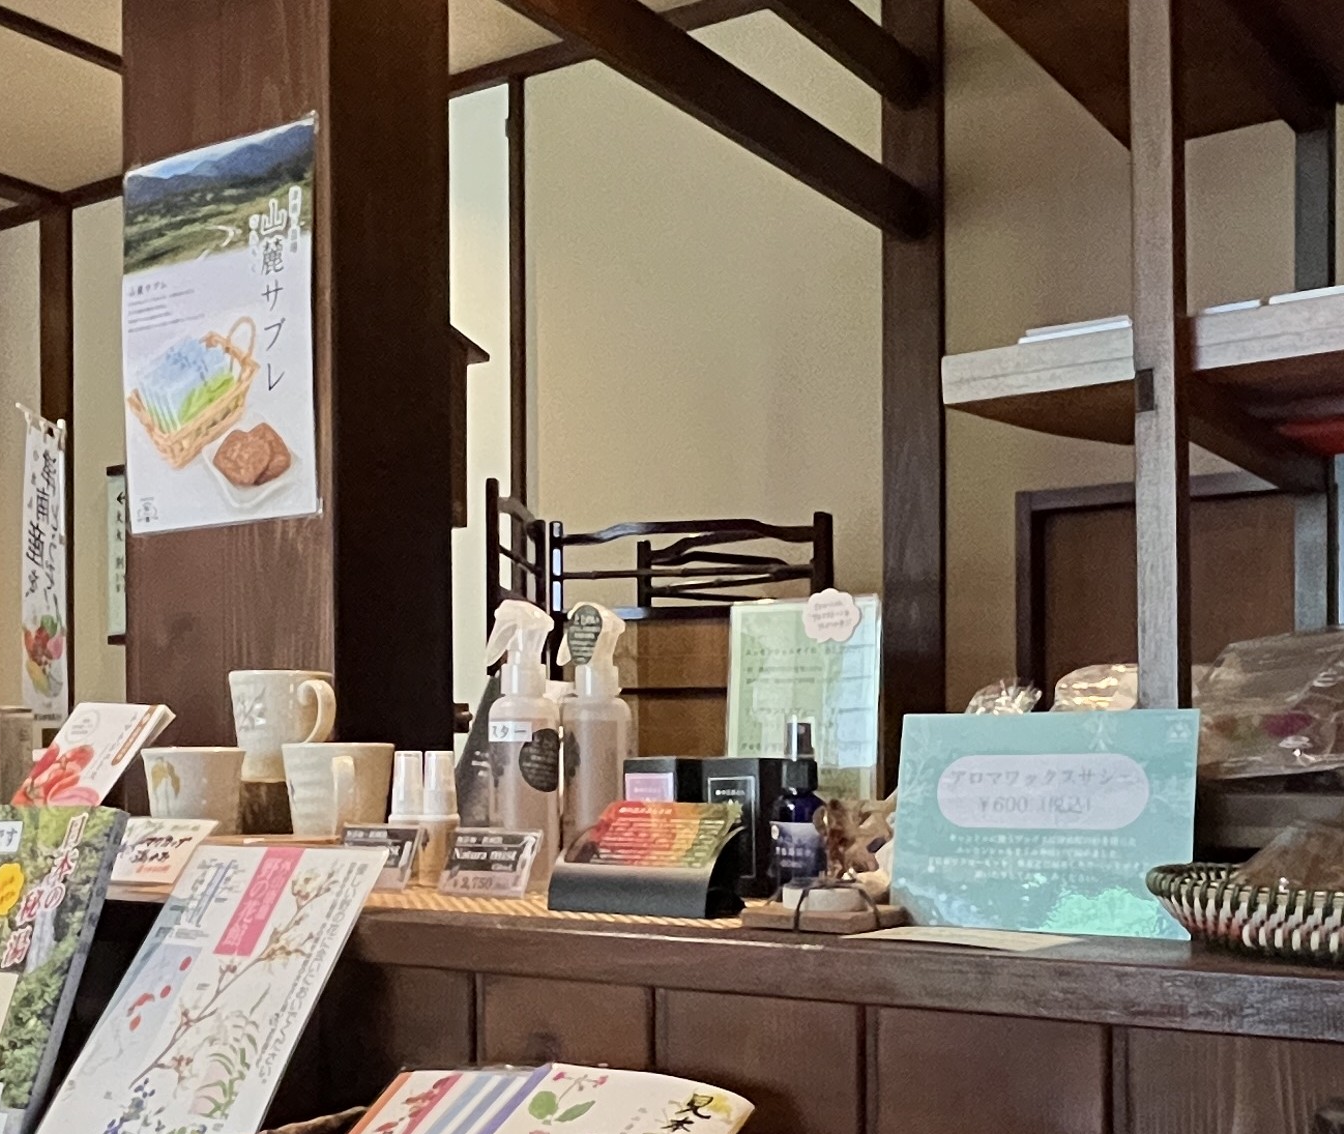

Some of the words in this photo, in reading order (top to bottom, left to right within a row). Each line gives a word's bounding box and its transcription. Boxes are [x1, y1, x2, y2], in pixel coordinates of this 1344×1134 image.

[260, 198, 287, 392] 山麓サブレ
